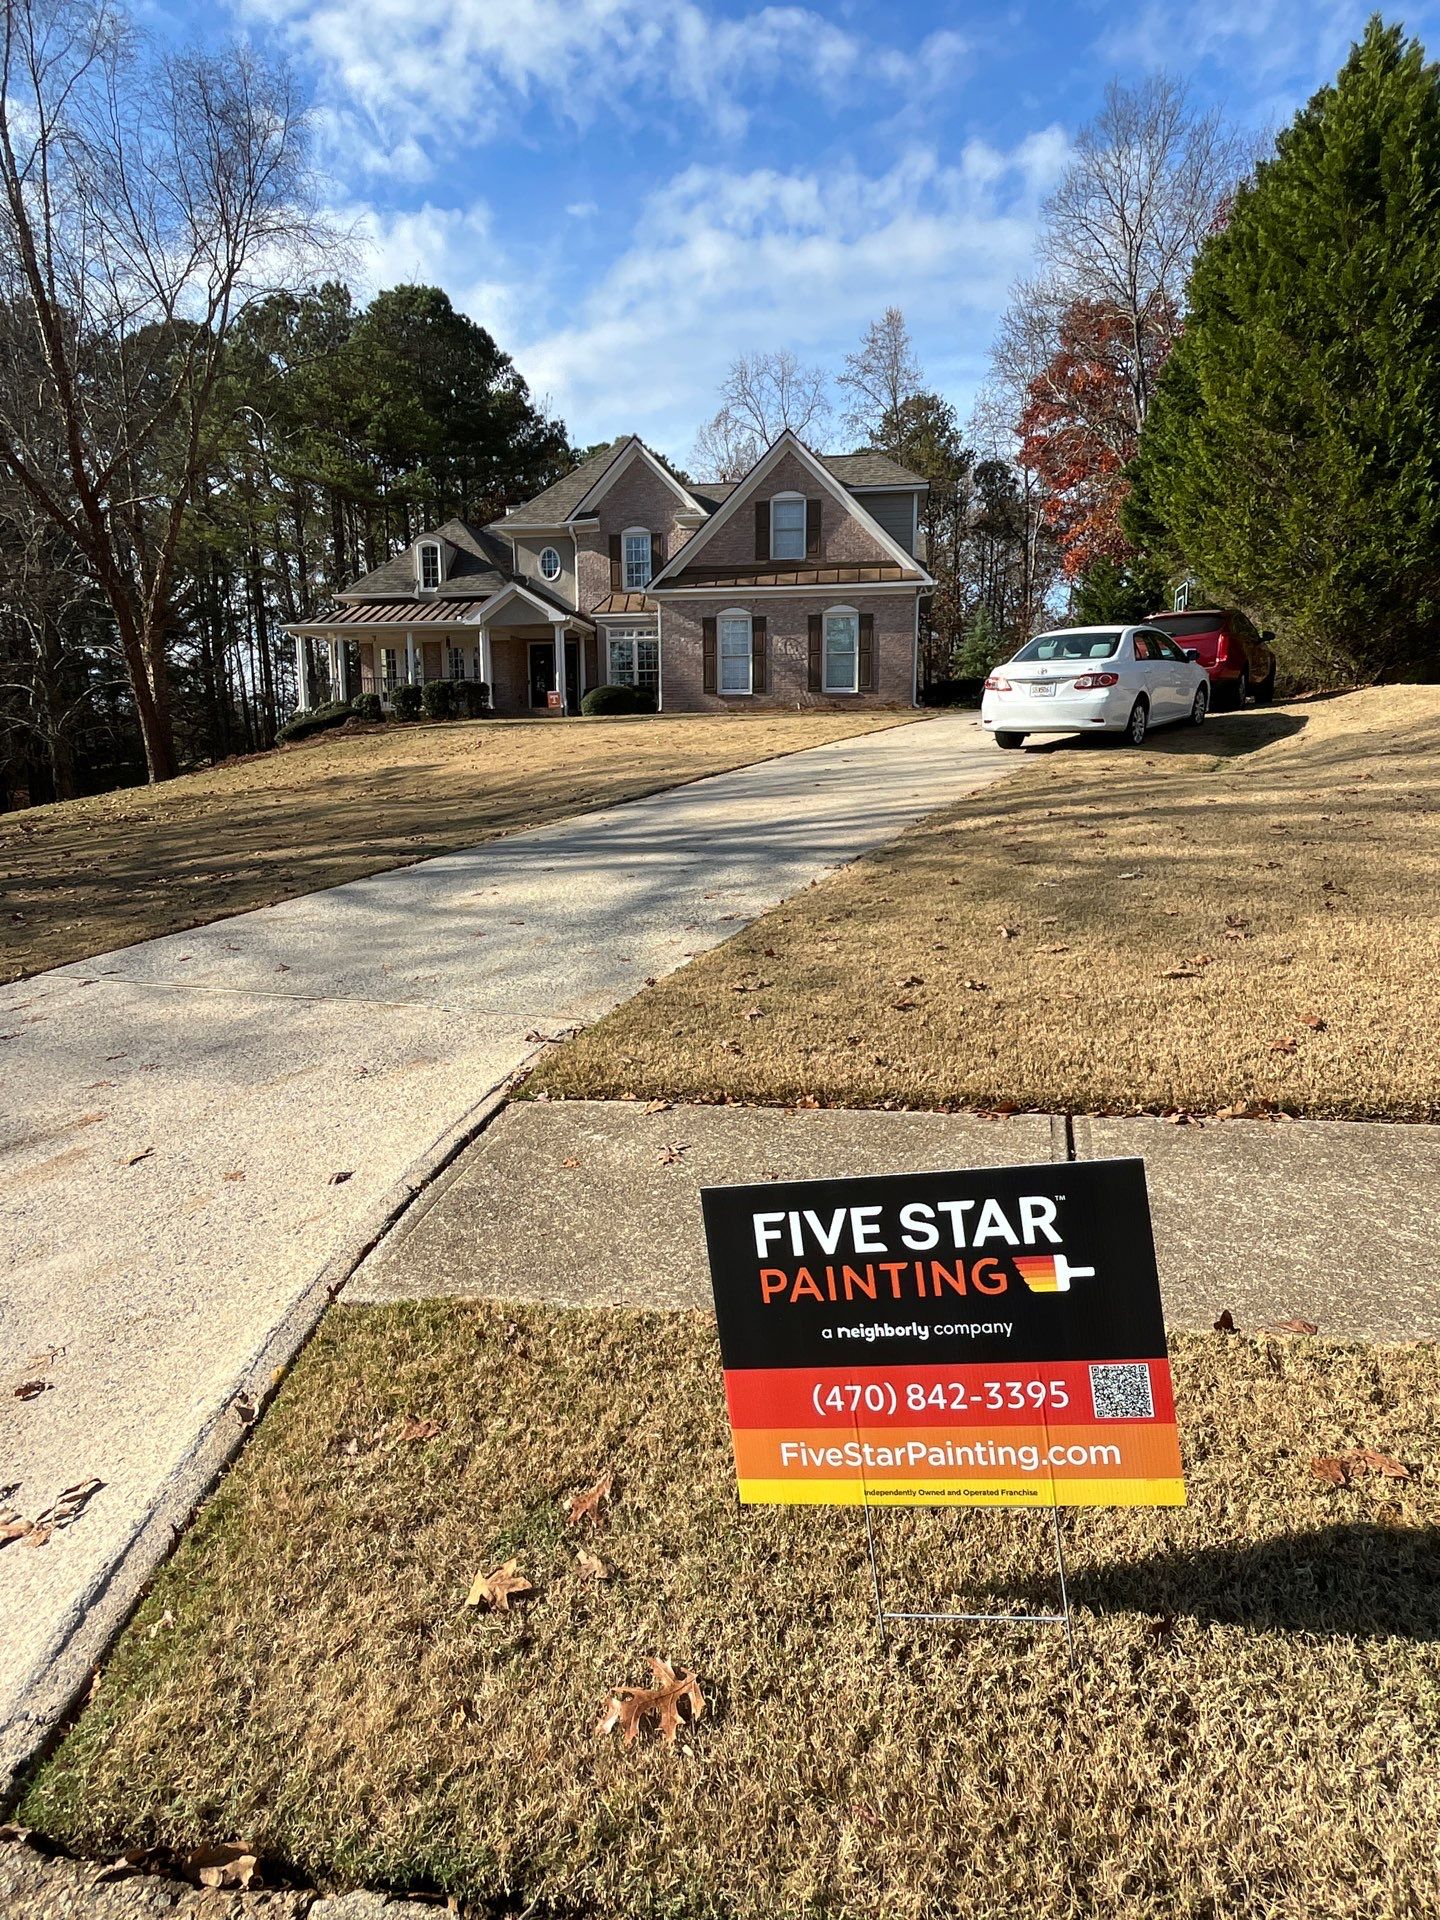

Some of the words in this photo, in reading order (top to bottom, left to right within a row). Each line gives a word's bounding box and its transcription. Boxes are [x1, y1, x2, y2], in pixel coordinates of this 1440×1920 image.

[753, 1206, 888, 1258] FIVE
[899, 1196, 1063, 1251] STAR
[759, 1257, 1008, 1304] PAINTING
[821, 1328, 833, 1339] a
[837, 1321, 930, 1342] neighborly
[933, 1322, 1013, 1339] company
[812, 1382, 897, 1415] (470)
[906, 1380, 1070, 1411] 842-3395
[780, 1440, 1122, 1471] FiveStarPainting.com
[864, 1488, 917, 1497] Independently
[918, 1488, 946, 1496] Owned
[947, 1488, 962, 1496] and
[963, 1488, 1000, 1497] Operated
[1001, 1488, 1038, 1496] Franchise
